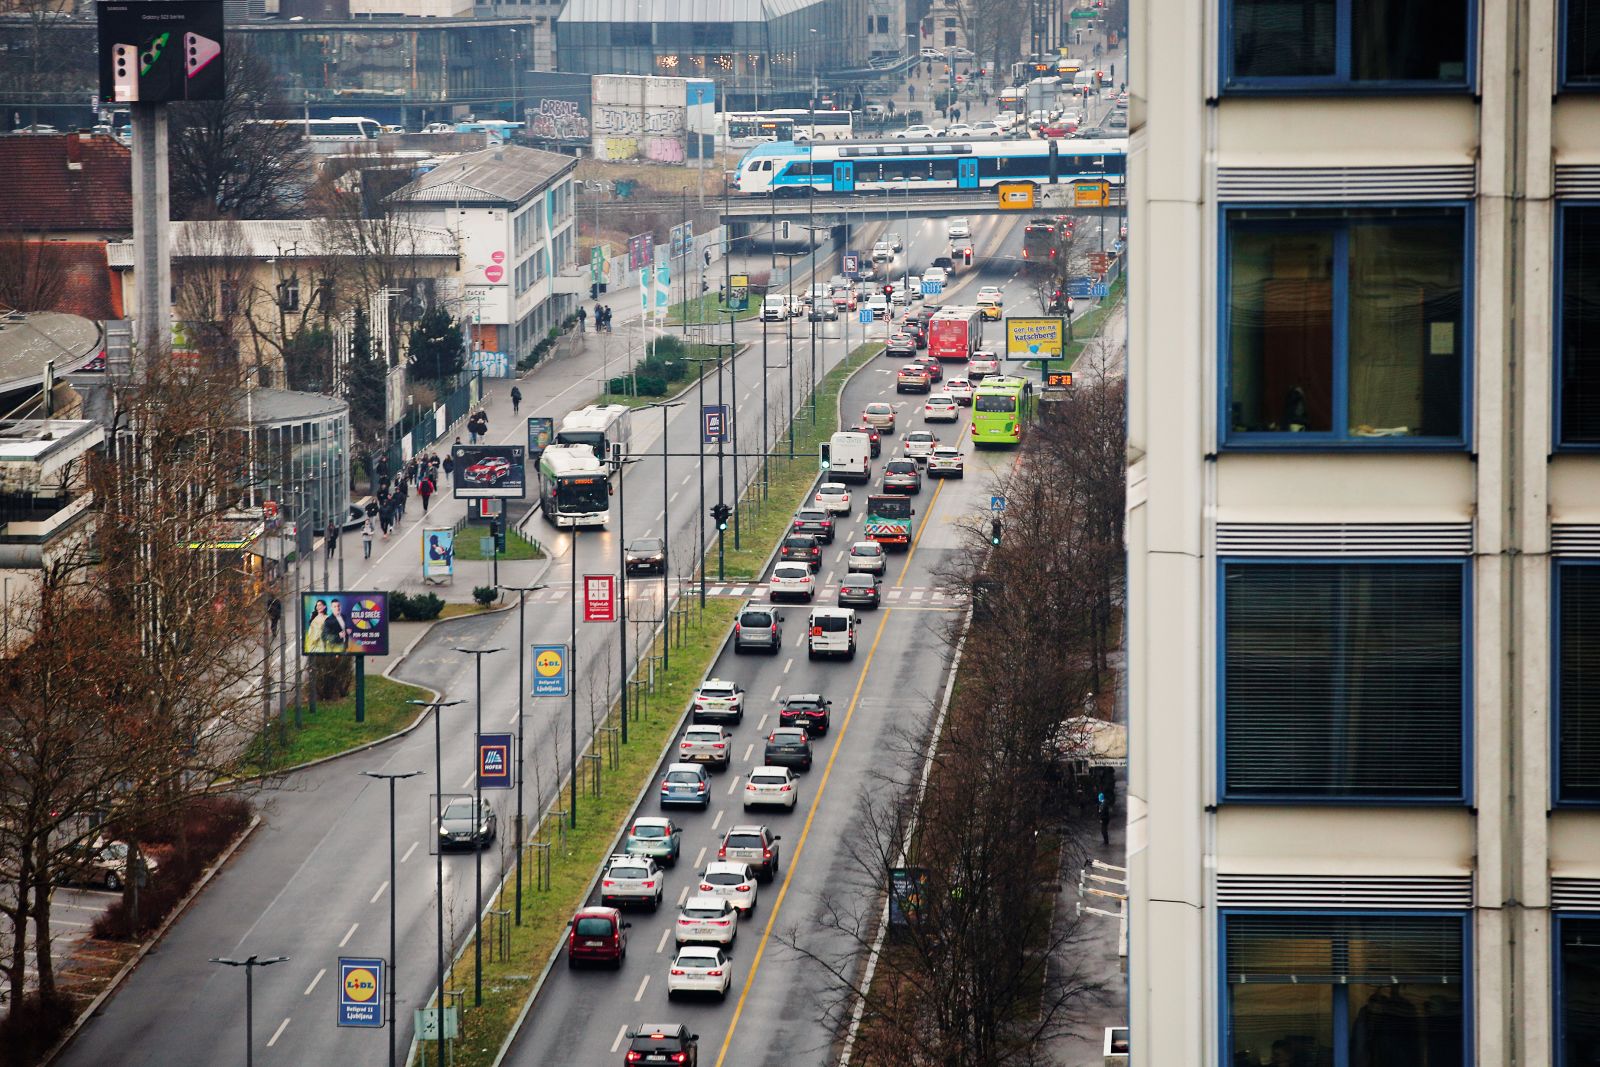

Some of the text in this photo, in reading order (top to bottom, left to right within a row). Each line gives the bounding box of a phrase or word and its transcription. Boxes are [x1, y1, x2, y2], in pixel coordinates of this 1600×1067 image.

[351, 610, 381, 619] KOLO SREČE
[346, 1012, 373, 1020] Ljubljana
